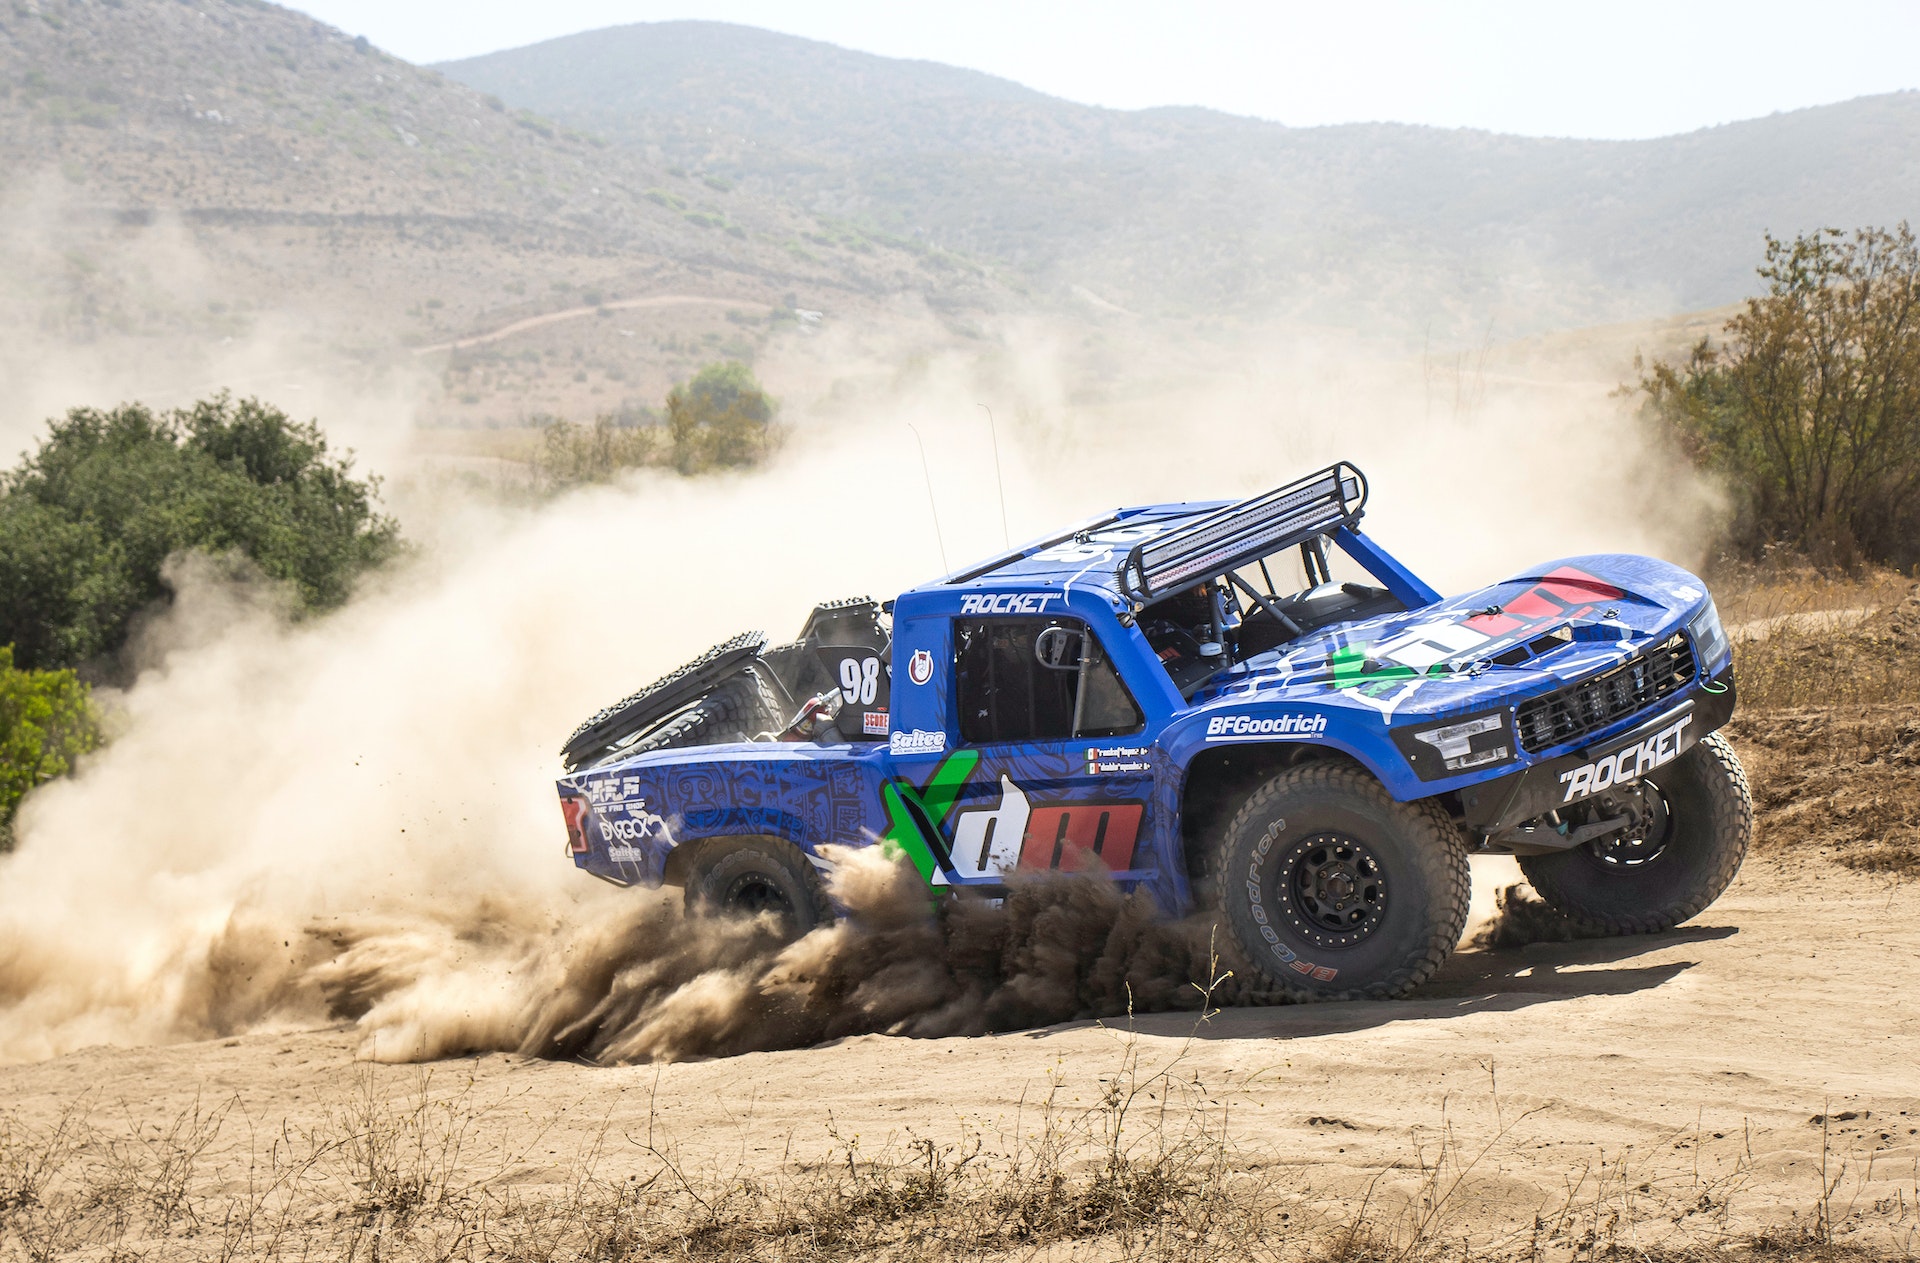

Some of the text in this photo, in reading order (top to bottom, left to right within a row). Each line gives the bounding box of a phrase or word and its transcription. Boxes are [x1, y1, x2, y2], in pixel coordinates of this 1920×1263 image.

[960, 592, 1063, 614] "ROCKET"
[840, 656, 880, 706] 98
[865, 713, 888, 728] SCORE
[1206, 713, 1328, 735] BFGoodrich
[891, 729, 945, 749] Saltee
[1559, 712, 1693, 803] "ROCKET"
[593, 805, 607, 814] THE
[625, 801, 646, 811] SHOP
[1246, 817, 1338, 982] BFGoodrich
